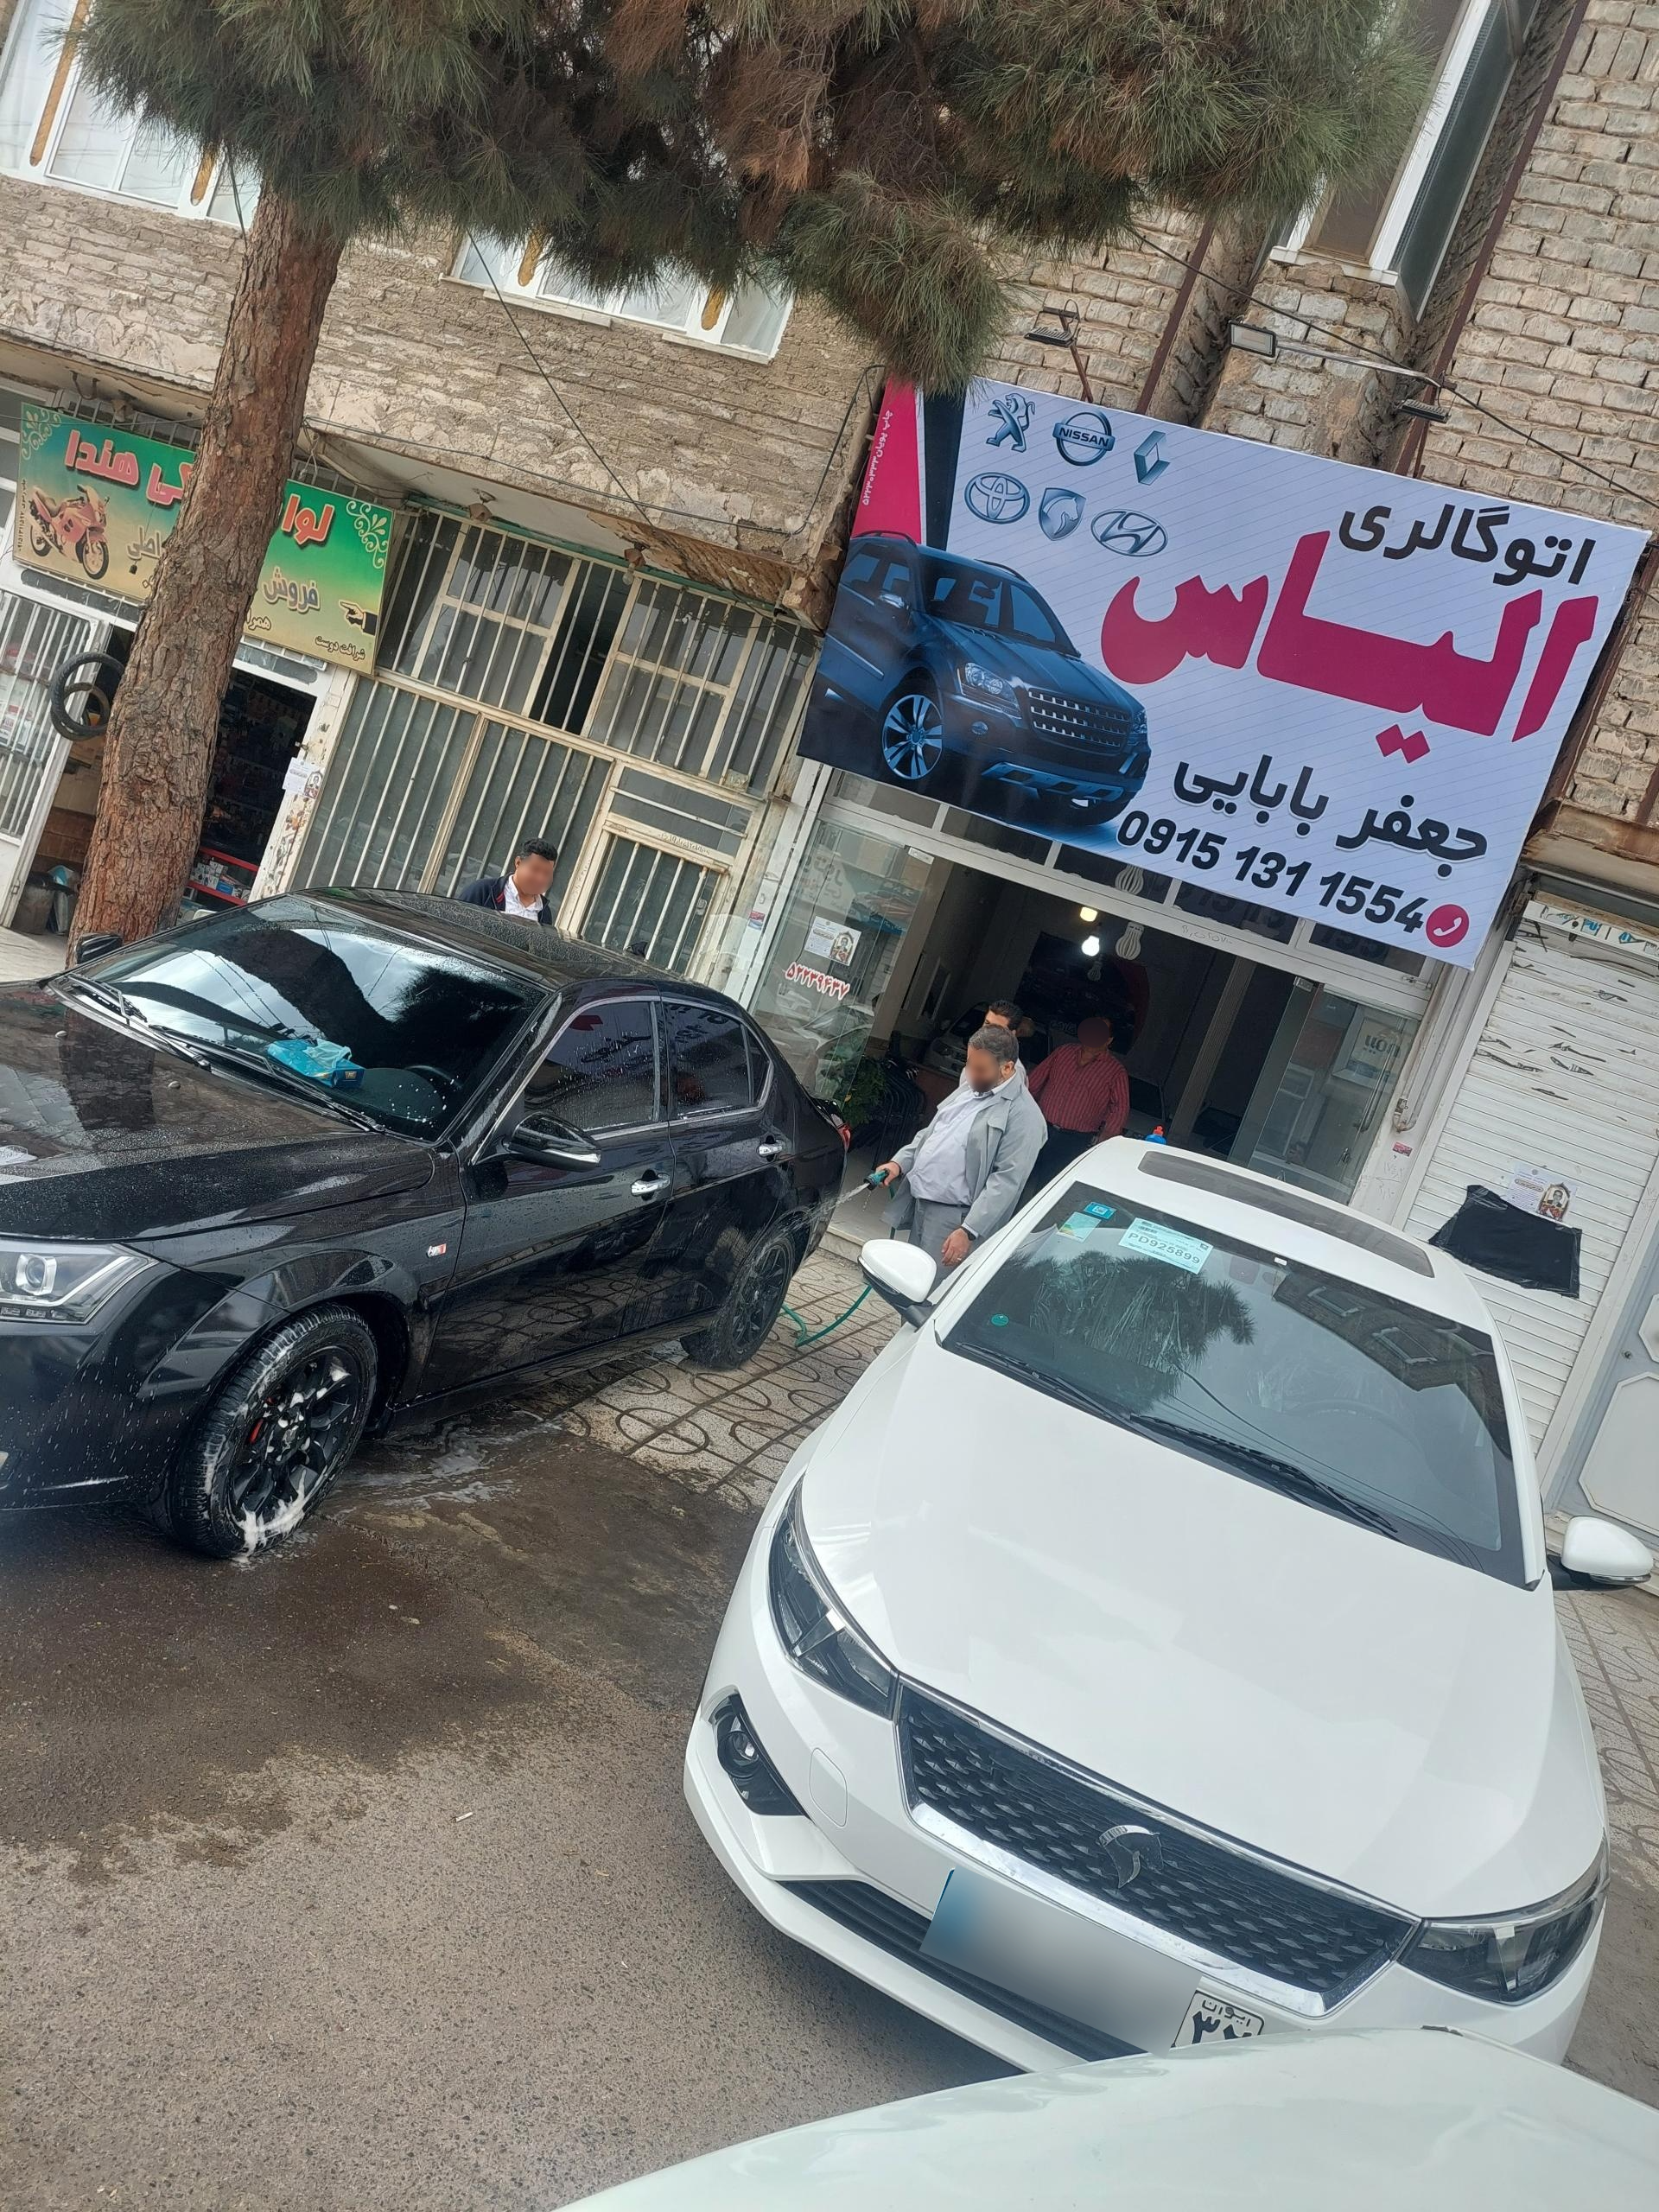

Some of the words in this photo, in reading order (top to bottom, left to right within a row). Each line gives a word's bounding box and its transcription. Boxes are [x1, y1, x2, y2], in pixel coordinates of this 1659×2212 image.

[881, 410, 893, 430] چاپ
[1058, 427, 1109, 447] NISSAN
[65, 429, 139, 486] هندا
[875, 432, 888, 457] پویان
[1338, 505, 1597, 586] اتوگالری
[263, 567, 321, 613] فروش
[246, 608, 271, 630] همرا
[315, 636, 339, 652] دوست
[1102, 531, 1599, 764] الیاس
[1173, 754, 1330, 836] بابایی
[1335, 794, 1487, 878] جعفر
[1117, 810, 1228, 870] 0915
[1235, 846, 1313, 897] 131
[1319, 871, 1429, 933] 1554
[1128, 1233, 1200, 1263] PD925899
